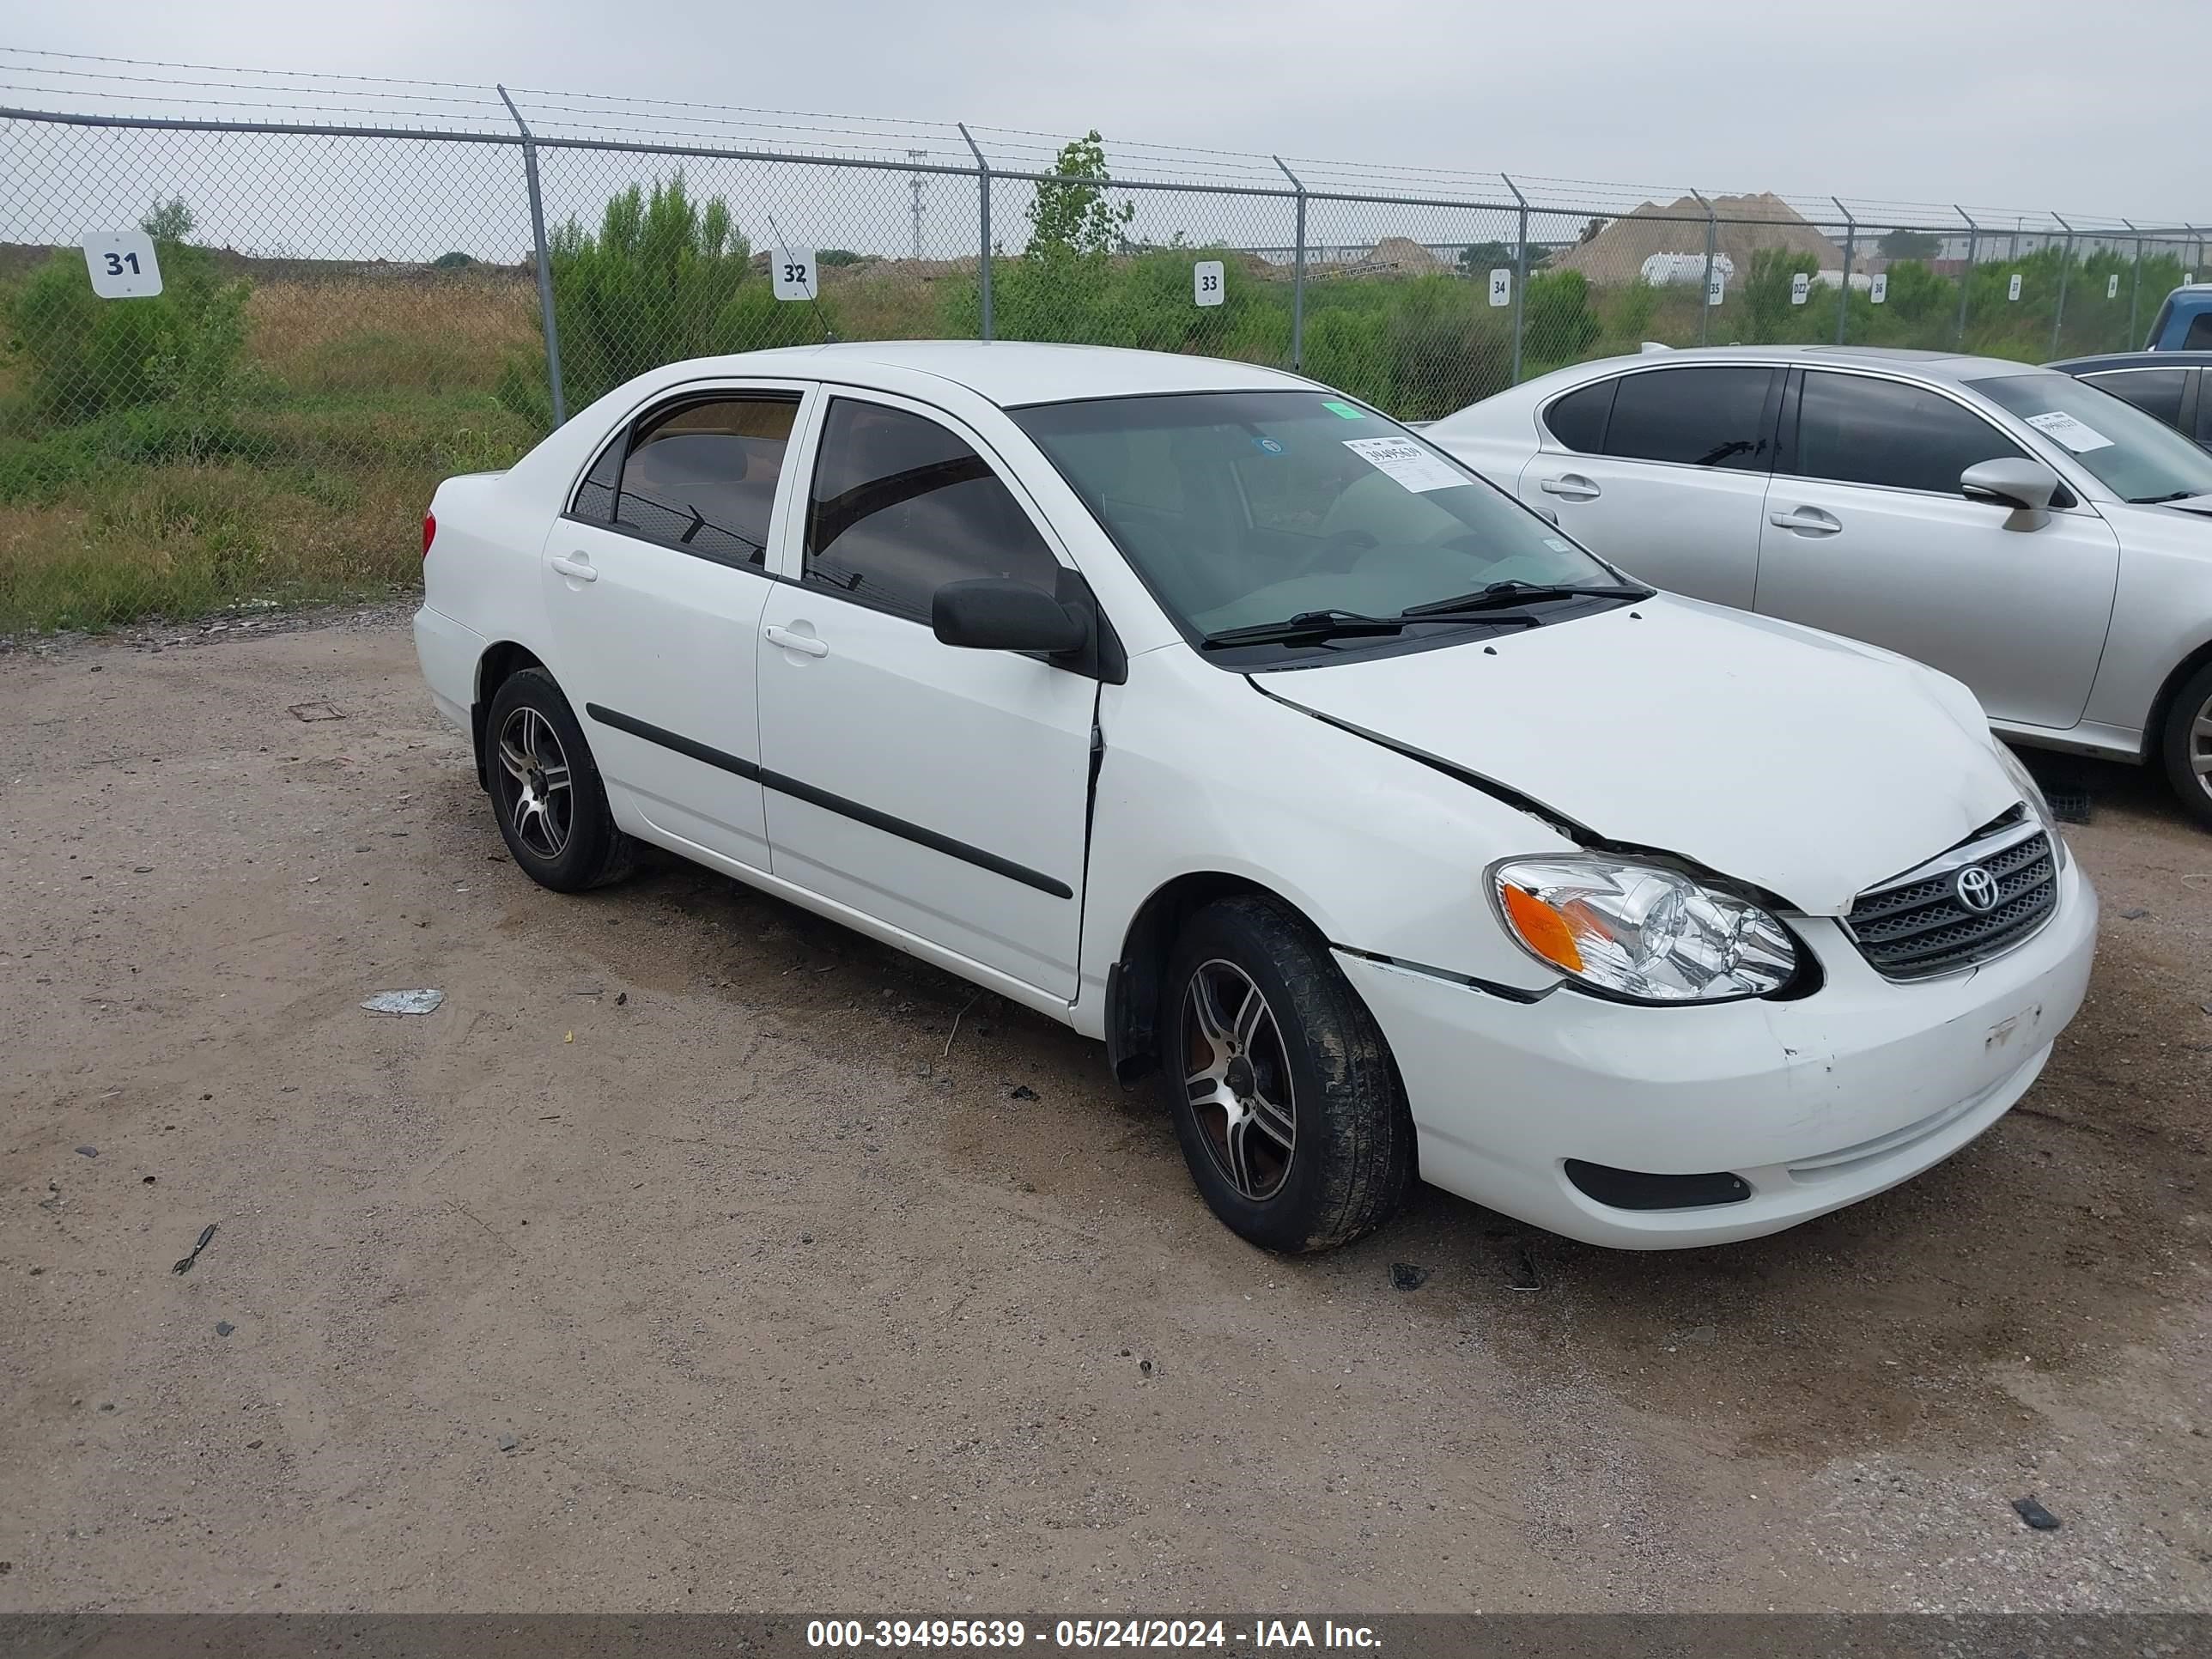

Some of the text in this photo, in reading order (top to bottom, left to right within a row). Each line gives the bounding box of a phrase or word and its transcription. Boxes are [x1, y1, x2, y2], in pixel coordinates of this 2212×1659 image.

[103, 252, 141, 276] 31
[784, 264, 806, 283] 32
[1202, 276, 1217, 291] 33
[1494, 281, 1505, 294] 34
[1710, 283, 1720, 295] 35
[1875, 283, 1883, 294] 36
[1365, 447, 1423, 461] 39495639
